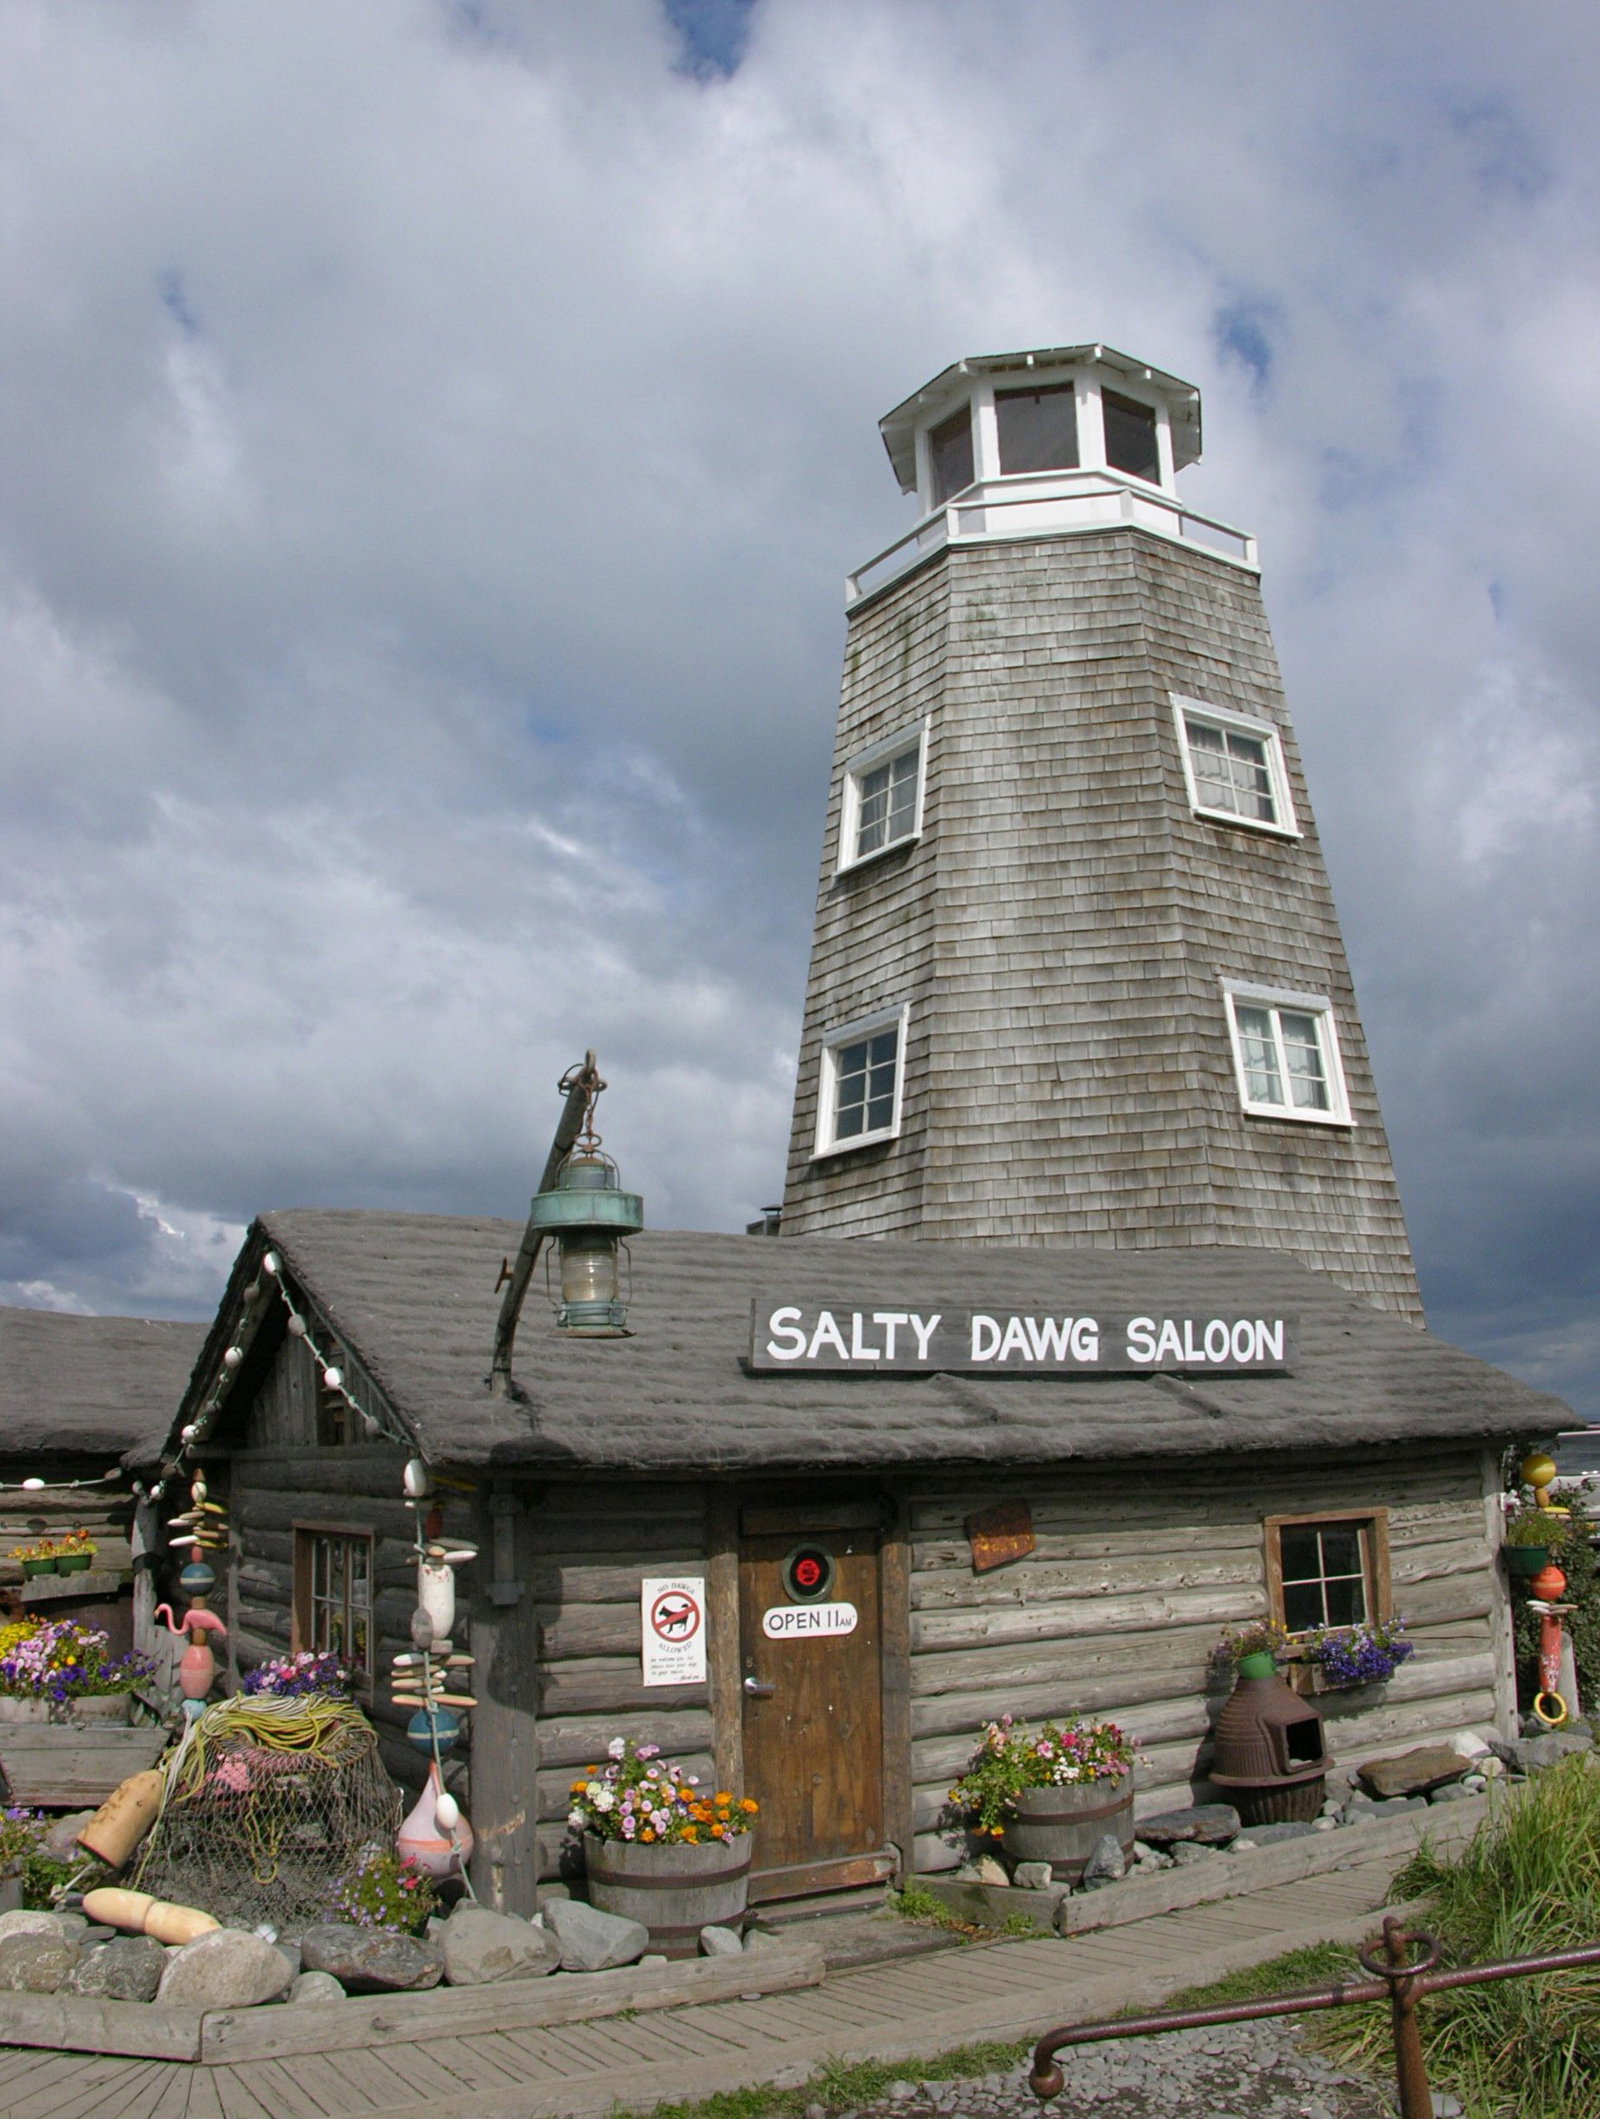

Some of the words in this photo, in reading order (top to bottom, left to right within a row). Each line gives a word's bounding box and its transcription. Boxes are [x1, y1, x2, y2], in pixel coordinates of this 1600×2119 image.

[766, 1307, 942, 1360] SALTY
[970, 1314, 1099, 1361] DAWG
[1126, 1317, 1285, 1362] SALOON
[657, 1584, 669, 1593] NO
[769, 1611, 820, 1631] OPEN
[659, 1641, 693, 1654] ALLOWED
